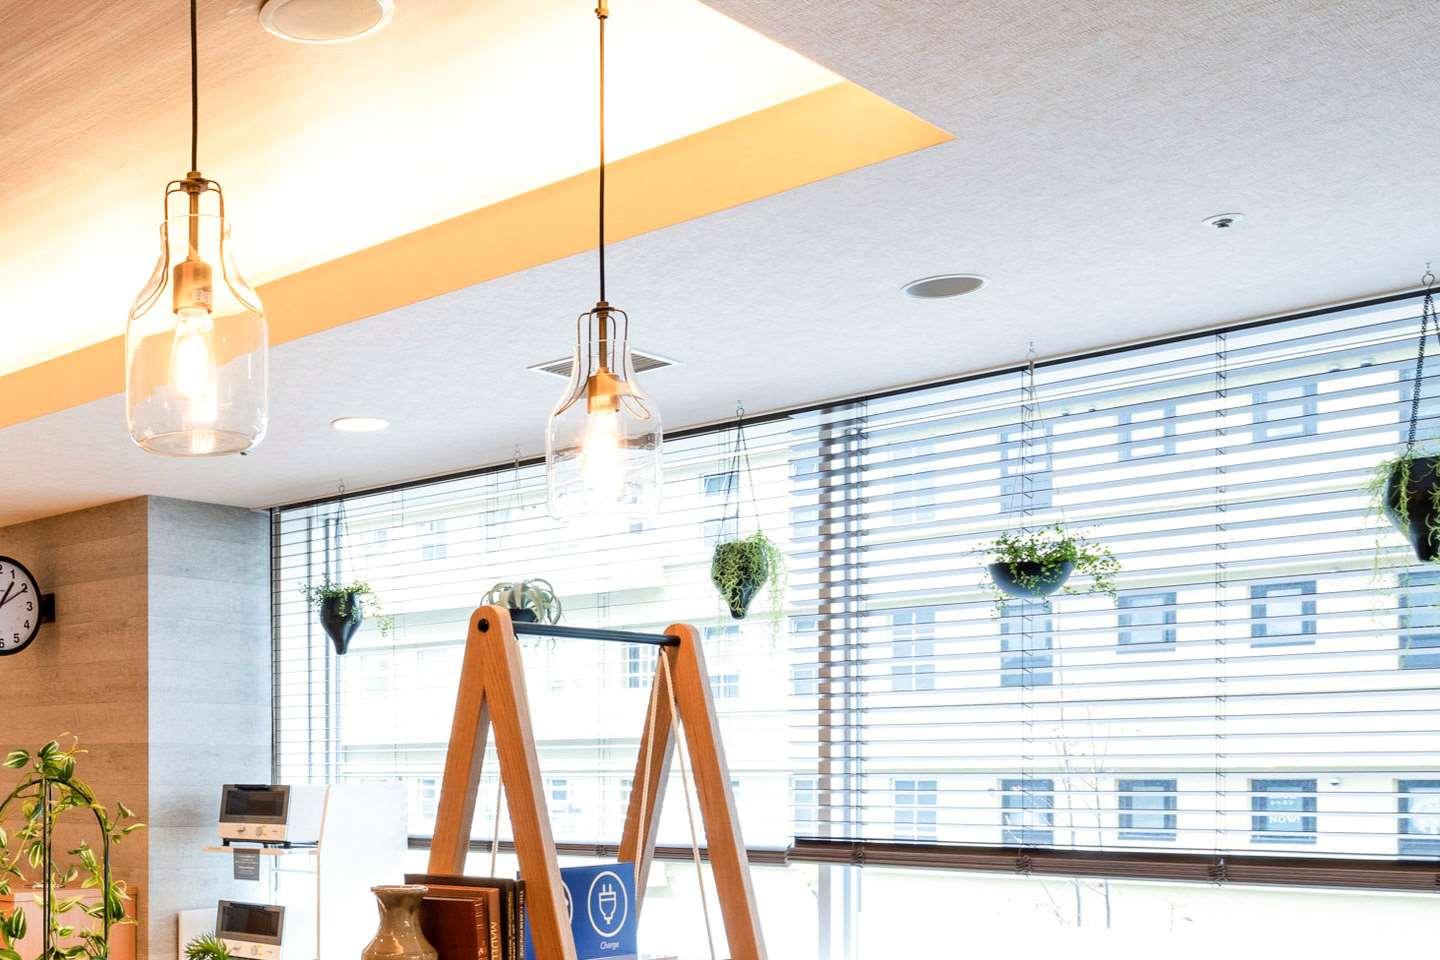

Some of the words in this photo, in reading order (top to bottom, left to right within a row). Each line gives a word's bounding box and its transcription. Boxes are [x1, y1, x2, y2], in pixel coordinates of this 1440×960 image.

[10, 569, 16, 579] 1
[26, 601, 33, 611] 3
[24, 620, 30, 629] 4
[0, 638, 5, 648] 6
[14, 633, 20, 643] 5
